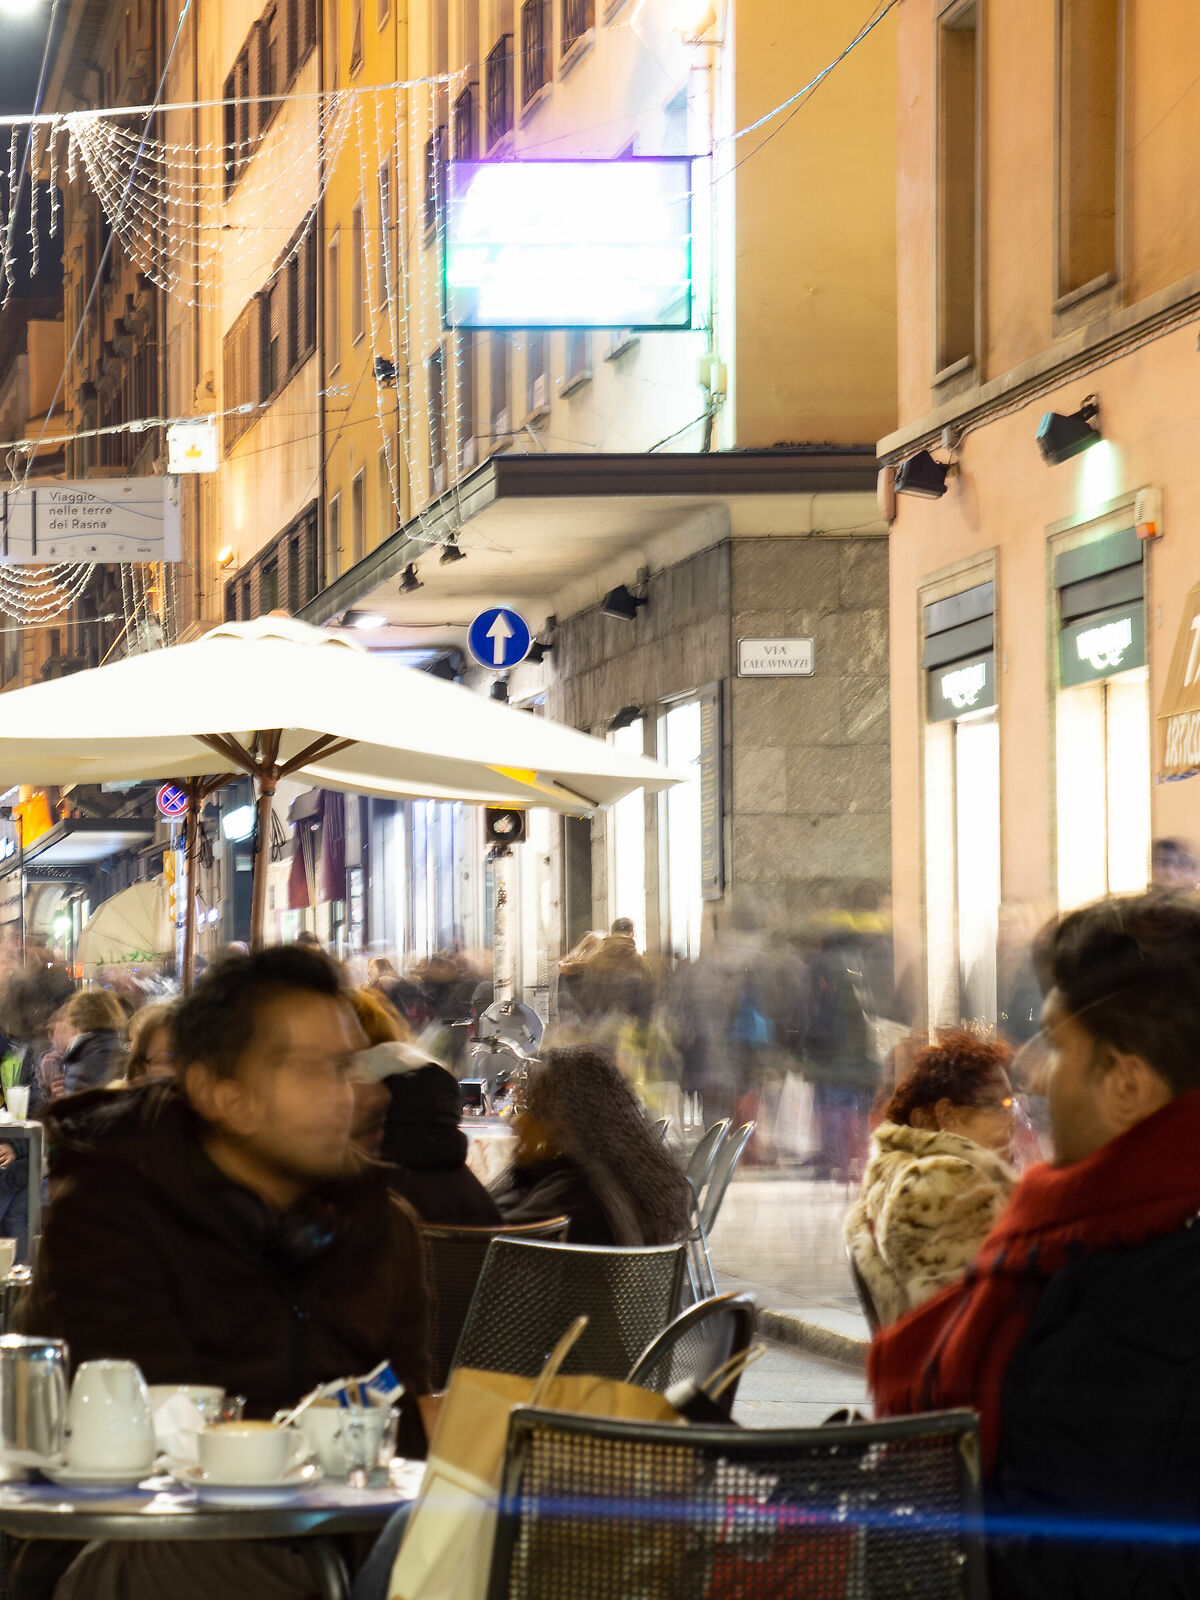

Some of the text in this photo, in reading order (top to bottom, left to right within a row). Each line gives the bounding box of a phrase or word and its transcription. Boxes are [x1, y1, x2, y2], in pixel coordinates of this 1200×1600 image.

[49, 492, 96, 504] Viaggio
[49, 505, 112, 516] nelle terre
[49, 520, 107, 530] dei Rasna
[764, 646, 787, 655] VIA
